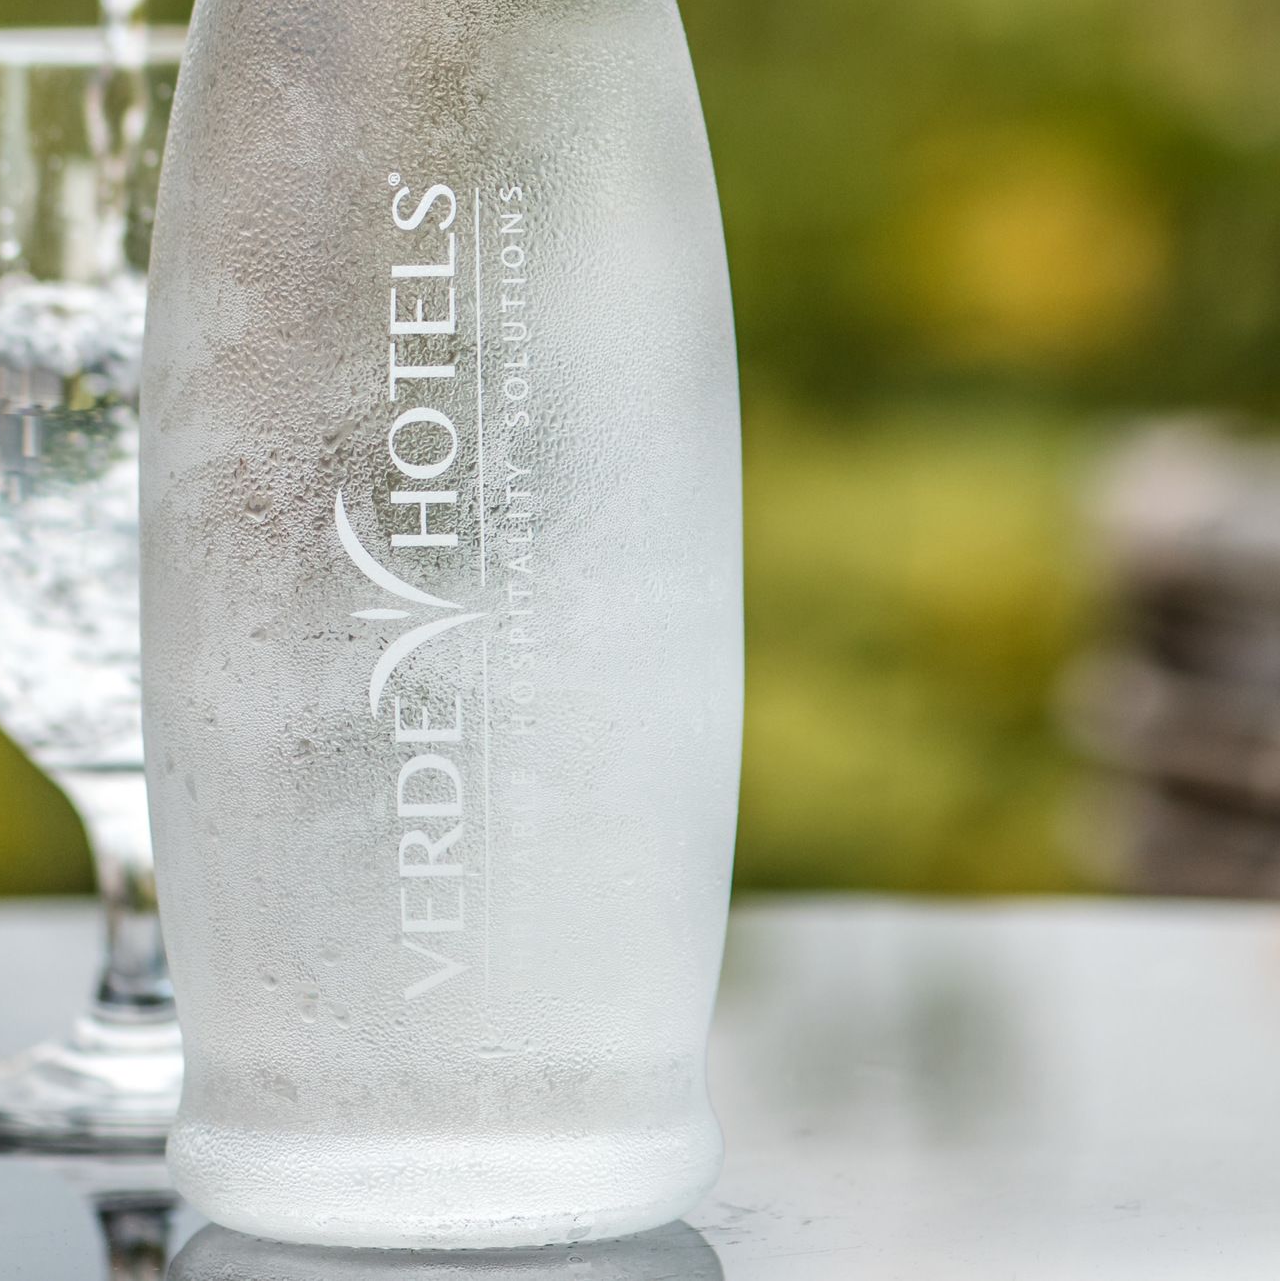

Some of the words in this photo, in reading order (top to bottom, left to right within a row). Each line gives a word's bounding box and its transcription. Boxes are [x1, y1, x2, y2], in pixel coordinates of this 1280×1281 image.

[500, 185, 530, 428] SOLUTIONS
[505, 461, 535, 736] HOSPITALITY
[394, 695, 471, 1002] VERDE
